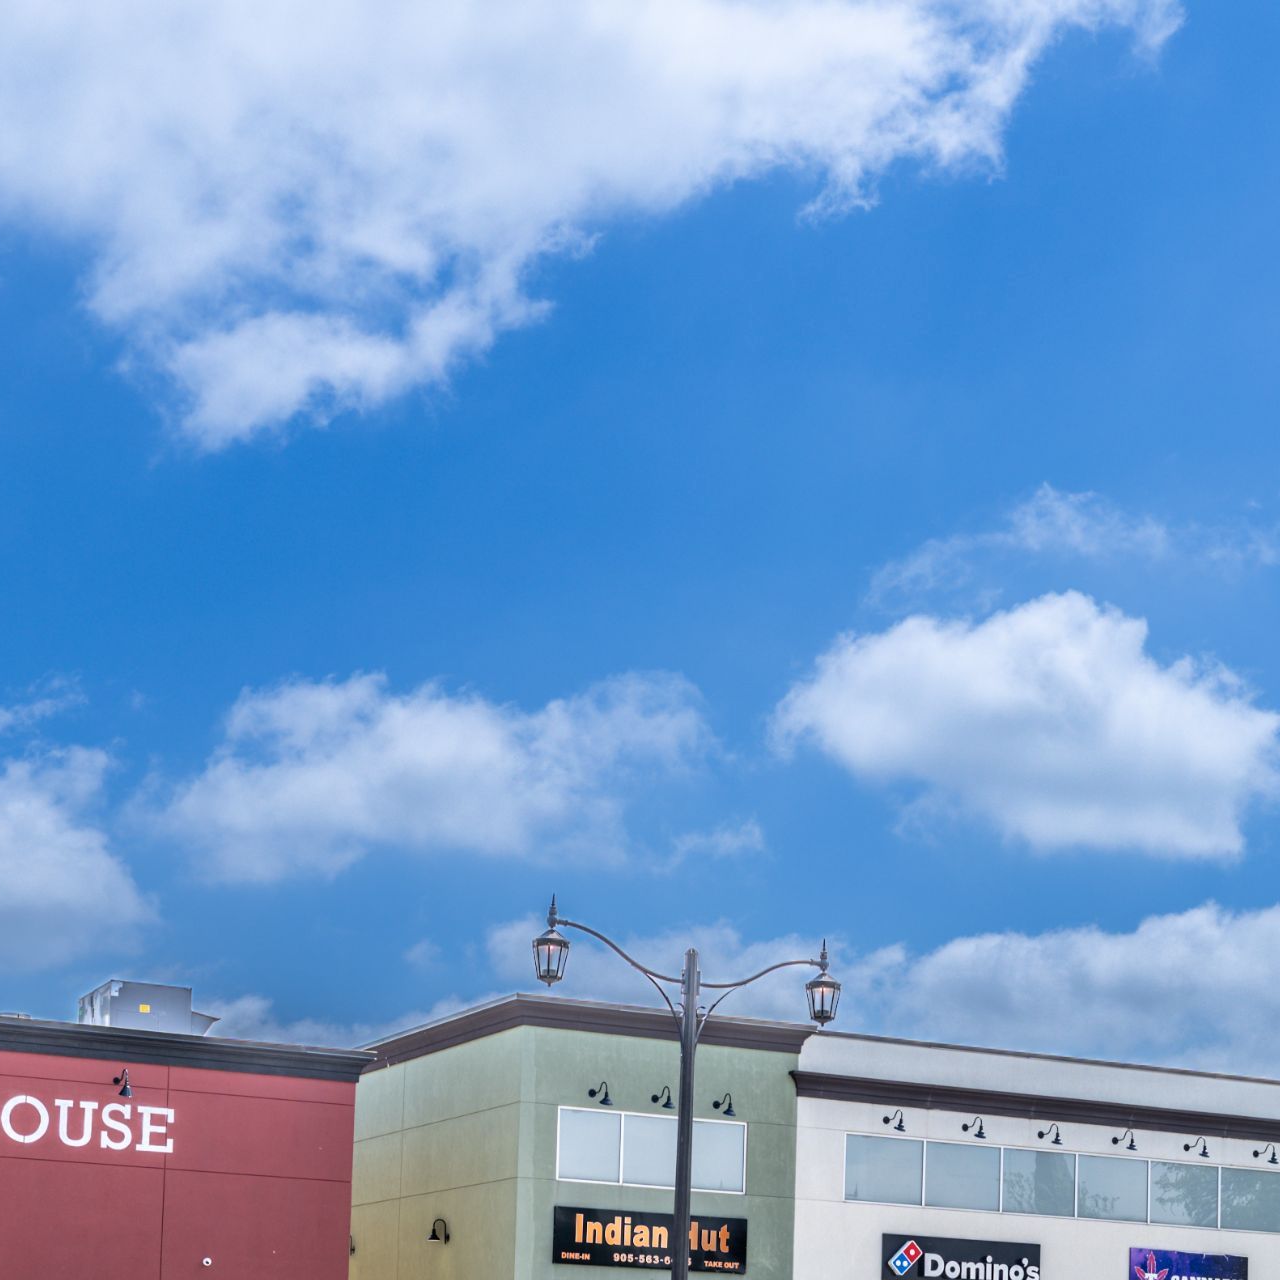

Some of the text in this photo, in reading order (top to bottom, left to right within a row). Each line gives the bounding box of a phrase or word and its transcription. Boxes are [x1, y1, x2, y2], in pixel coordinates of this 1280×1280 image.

[575, 1212, 669, 1249] Indian
[561, 1252, 590, 1260] DINE-IN
[704, 1260, 740, 1270] TAKE OUT
